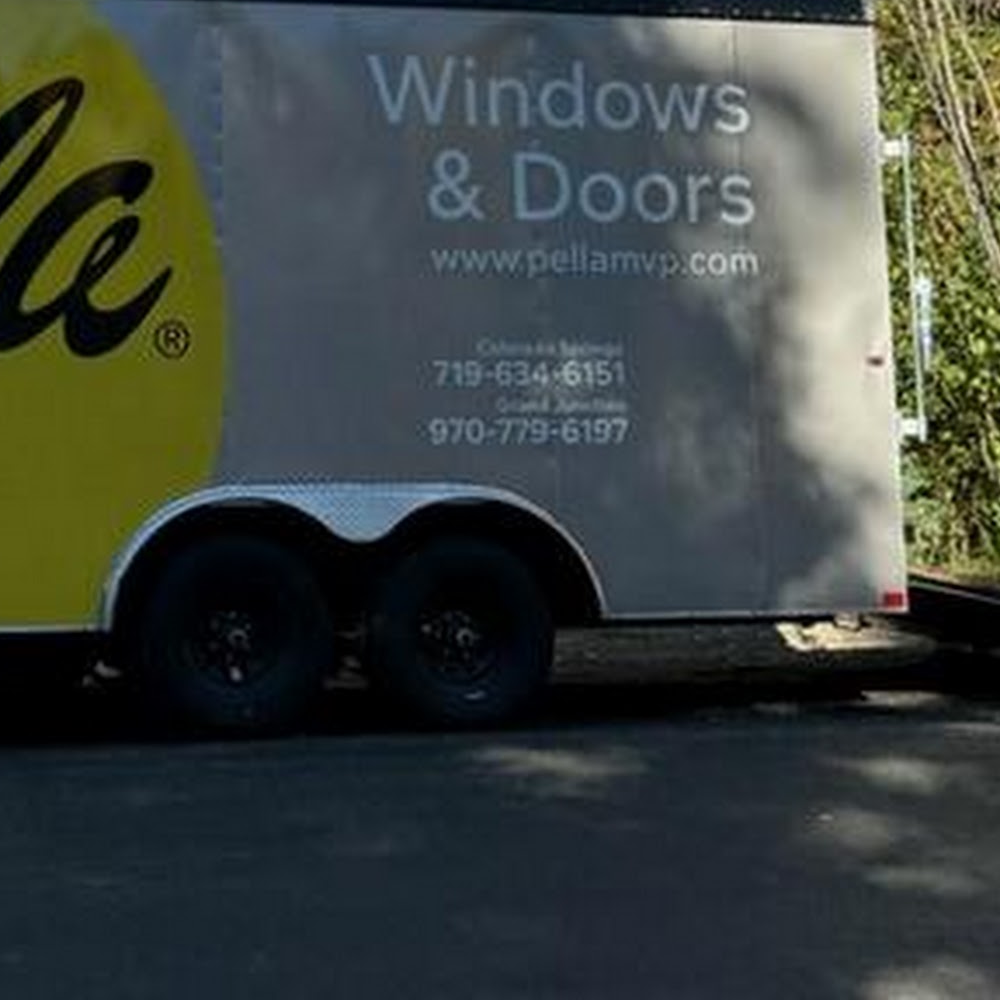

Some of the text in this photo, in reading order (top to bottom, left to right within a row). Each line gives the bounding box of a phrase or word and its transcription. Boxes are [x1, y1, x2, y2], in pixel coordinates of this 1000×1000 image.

[366, 54, 751, 134] Windows
[427, 149, 756, 226] & Doors
[430, 243, 760, 278] www.pellamvp.com
[428, 416, 629, 445] 970-779-6197
